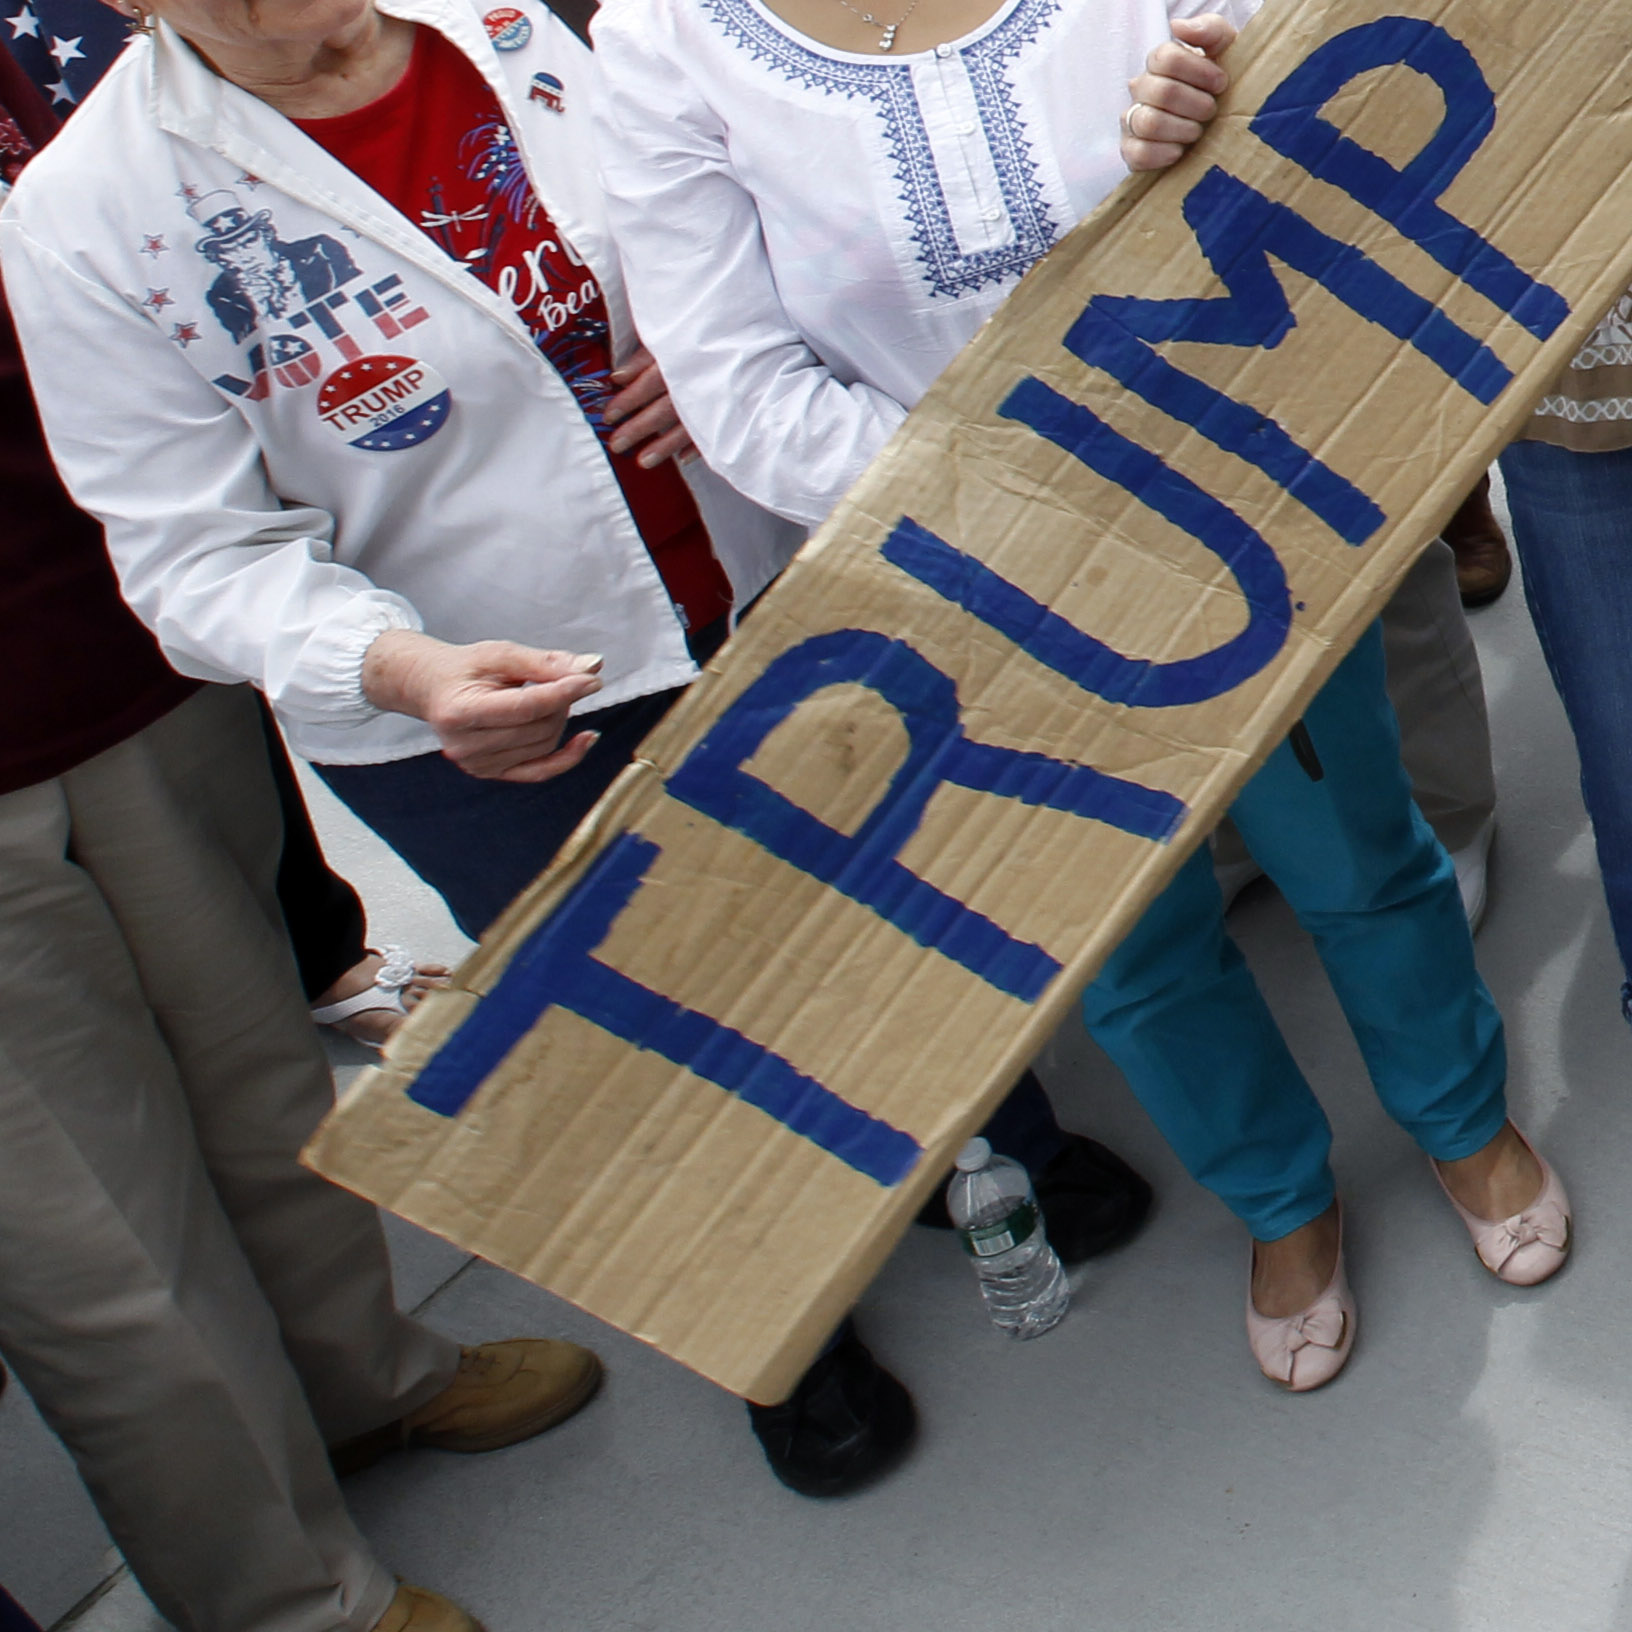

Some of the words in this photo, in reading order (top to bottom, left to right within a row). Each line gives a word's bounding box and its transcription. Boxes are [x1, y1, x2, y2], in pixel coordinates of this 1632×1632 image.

[321, 367, 425, 434] TRUMP
[368, 402, 406, 430] 2016
[407, 14, 1570, 1186] TRUMP
